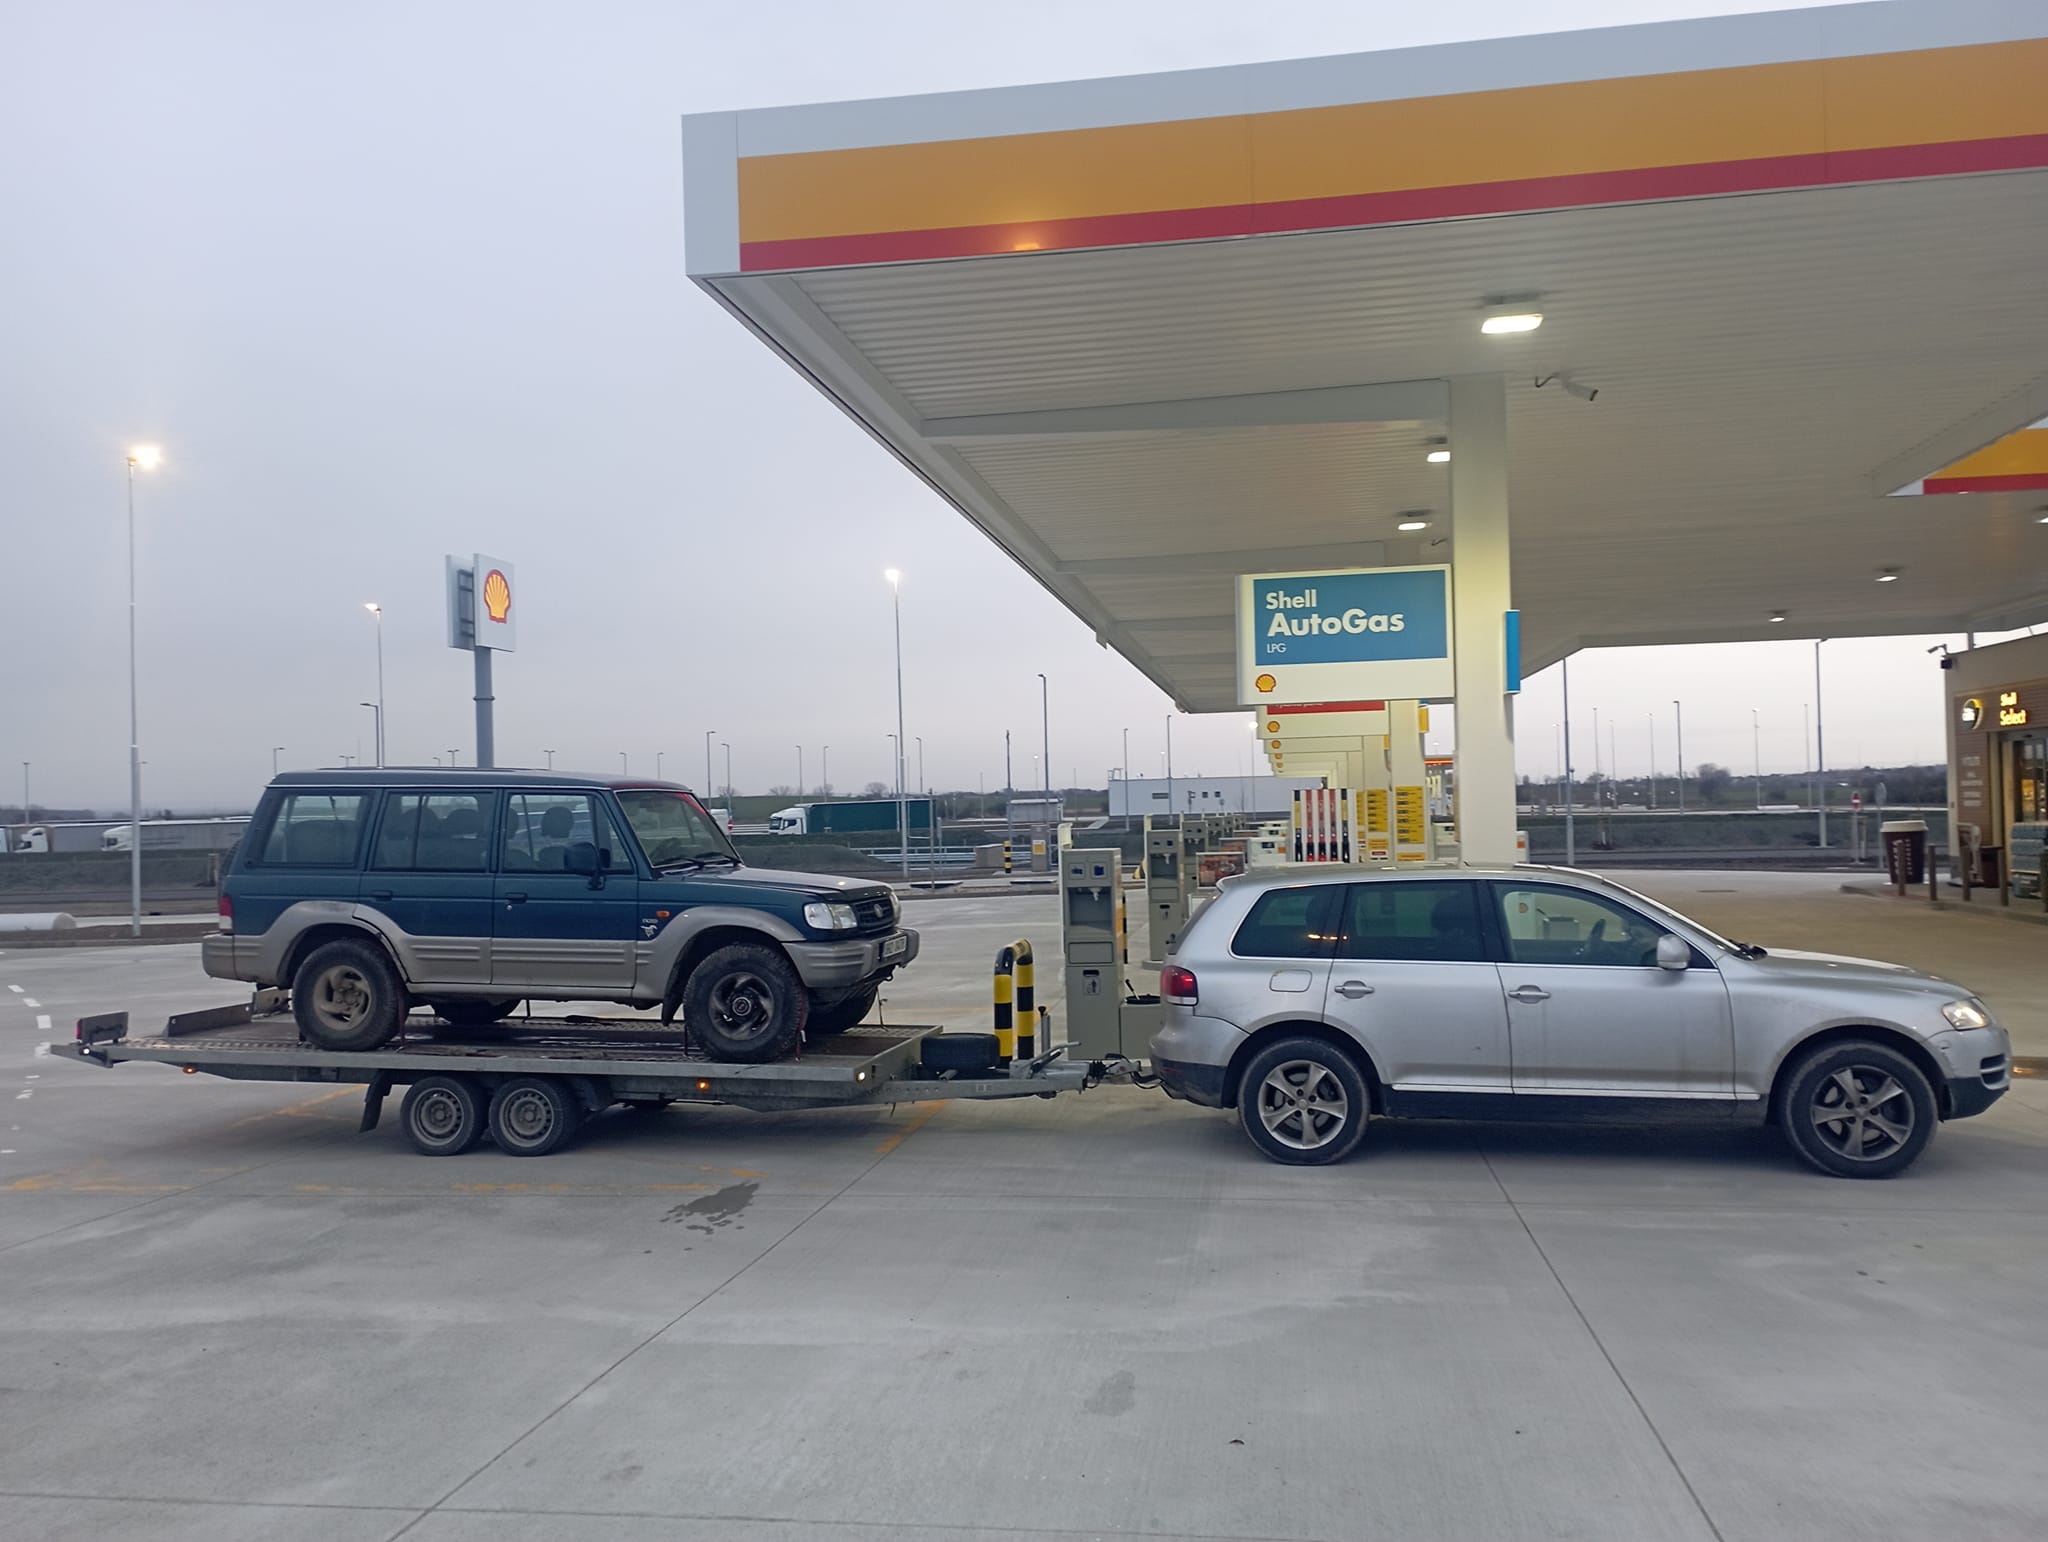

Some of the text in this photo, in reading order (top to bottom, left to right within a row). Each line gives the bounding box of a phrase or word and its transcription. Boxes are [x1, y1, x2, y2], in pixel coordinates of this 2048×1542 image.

[1266, 589, 1317, 609] Shell
[1267, 608, 1405, 637] AutoGas
[1266, 642, 1287, 653] LPG
